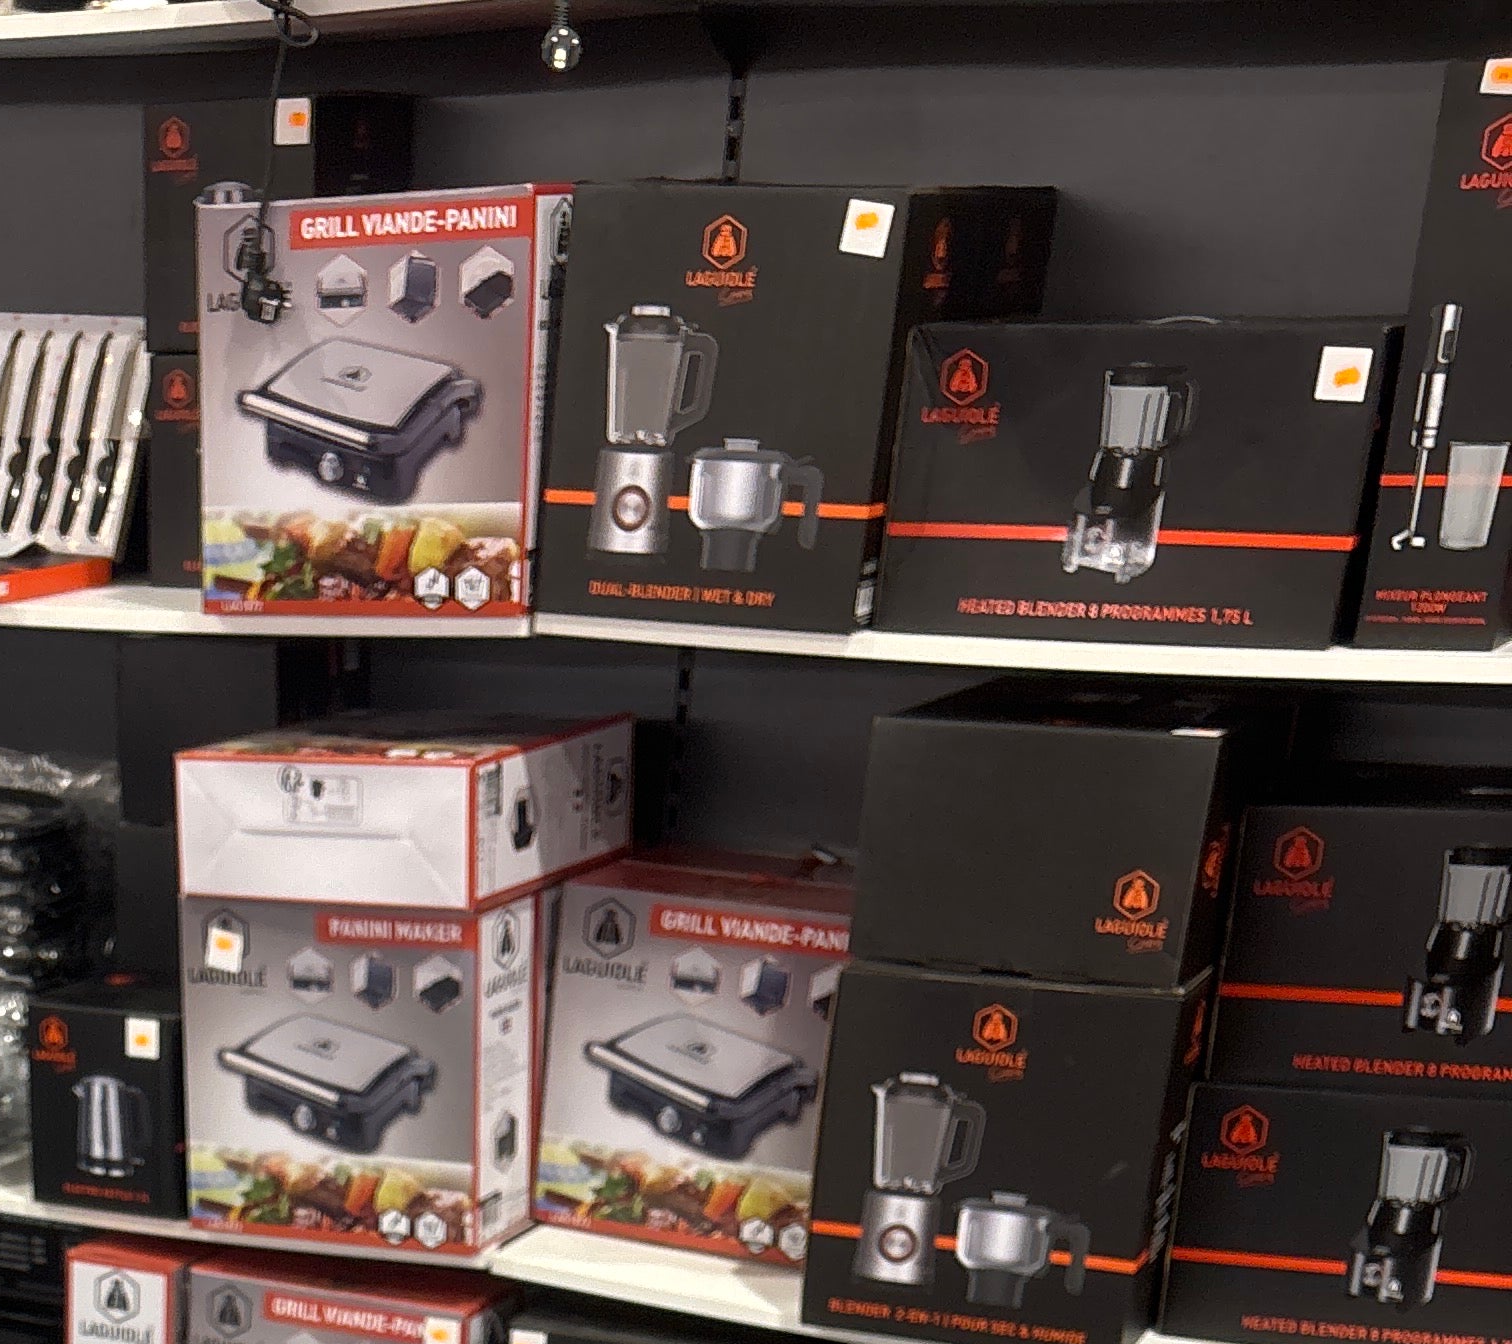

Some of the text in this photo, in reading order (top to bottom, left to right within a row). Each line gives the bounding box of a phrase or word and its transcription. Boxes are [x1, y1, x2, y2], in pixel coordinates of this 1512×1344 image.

[1460, 172, 1512, 189] LAGUI
[300, 205, 517, 239] GRILL VIANDE-PANINI
[957, 598, 1015, 616] HEATED
[1017, 600, 1086, 619] BLENDER
[1100, 603, 1206, 622] PROGRAMMES
[660, 909, 849, 951] GRILL VIANDE-PANI
[1353, 1058, 1425, 1079] BLENDER
[1241, 1314, 1297, 1334] HEATED
[1299, 1319, 1368, 1341] BLENDER
